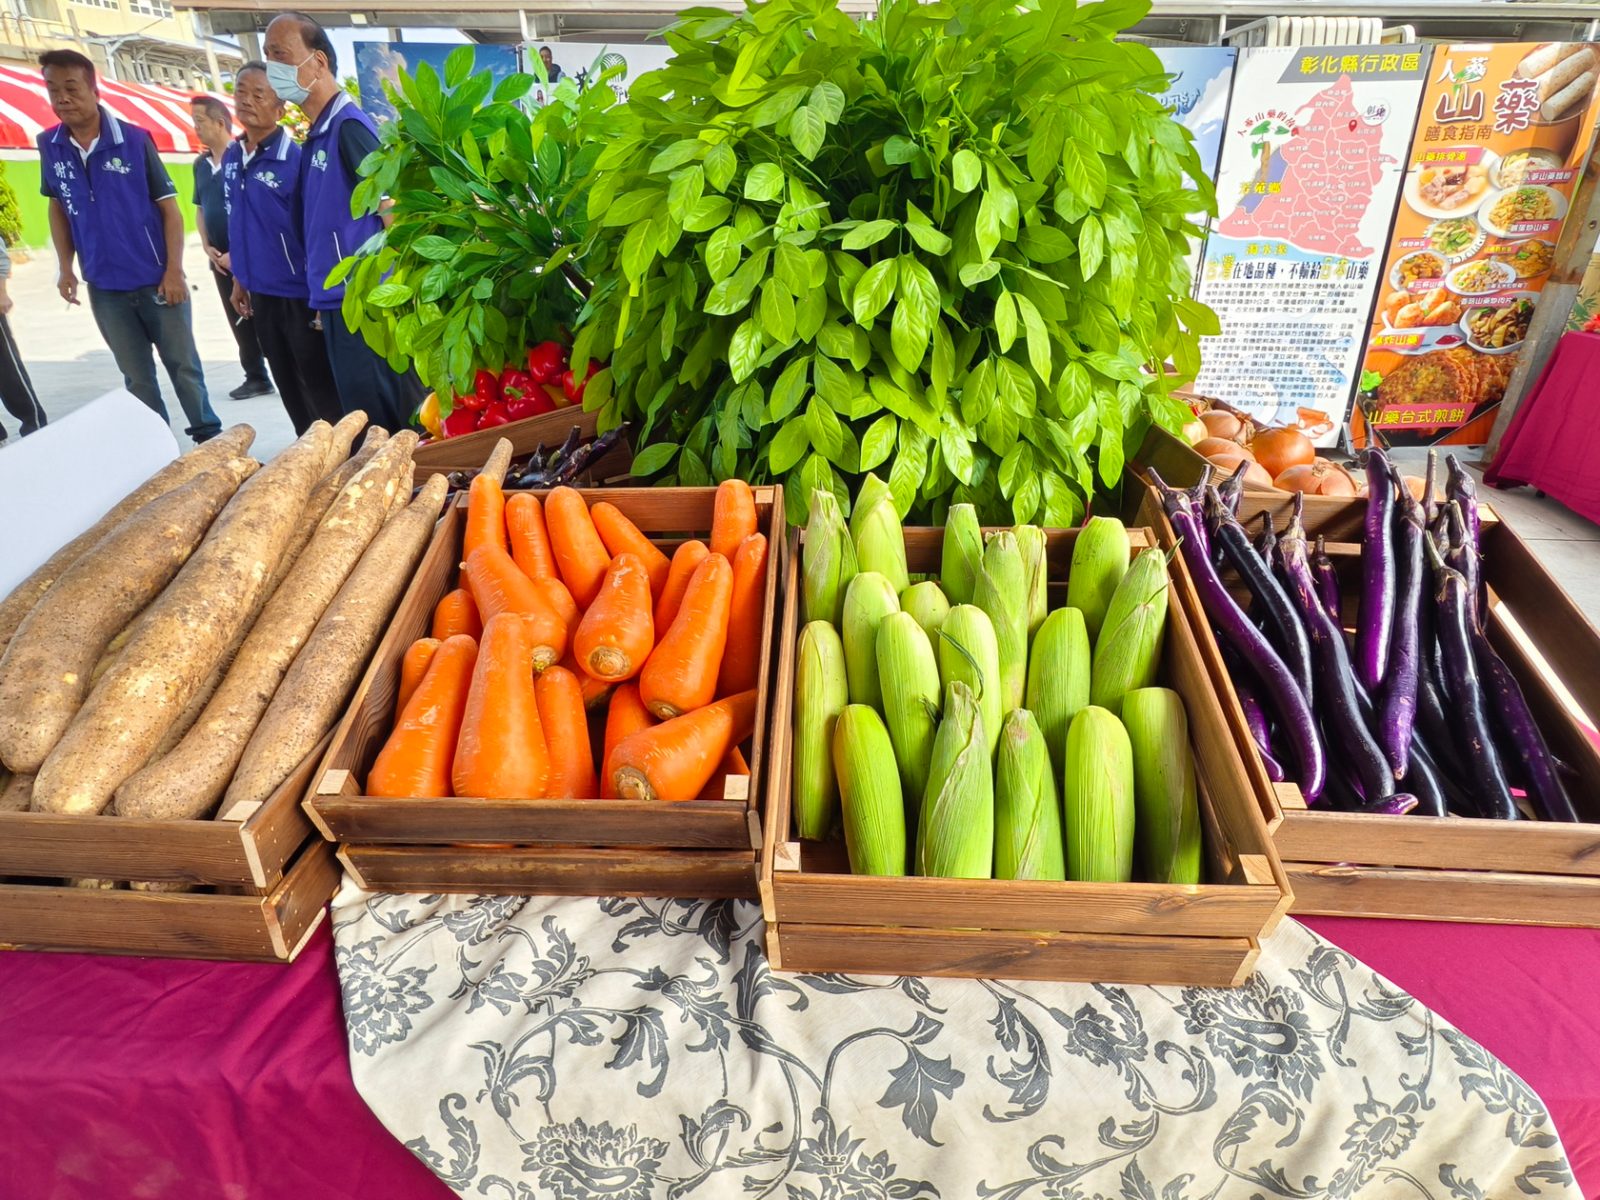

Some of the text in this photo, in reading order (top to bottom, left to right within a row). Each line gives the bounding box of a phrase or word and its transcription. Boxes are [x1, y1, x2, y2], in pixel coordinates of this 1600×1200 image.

[1299, 52, 1421, 74] 彰化縣行政區
[1424, 124, 1493, 142] 膳食指南
[1368, 409, 1464, 425] 山藥台式煎餅
